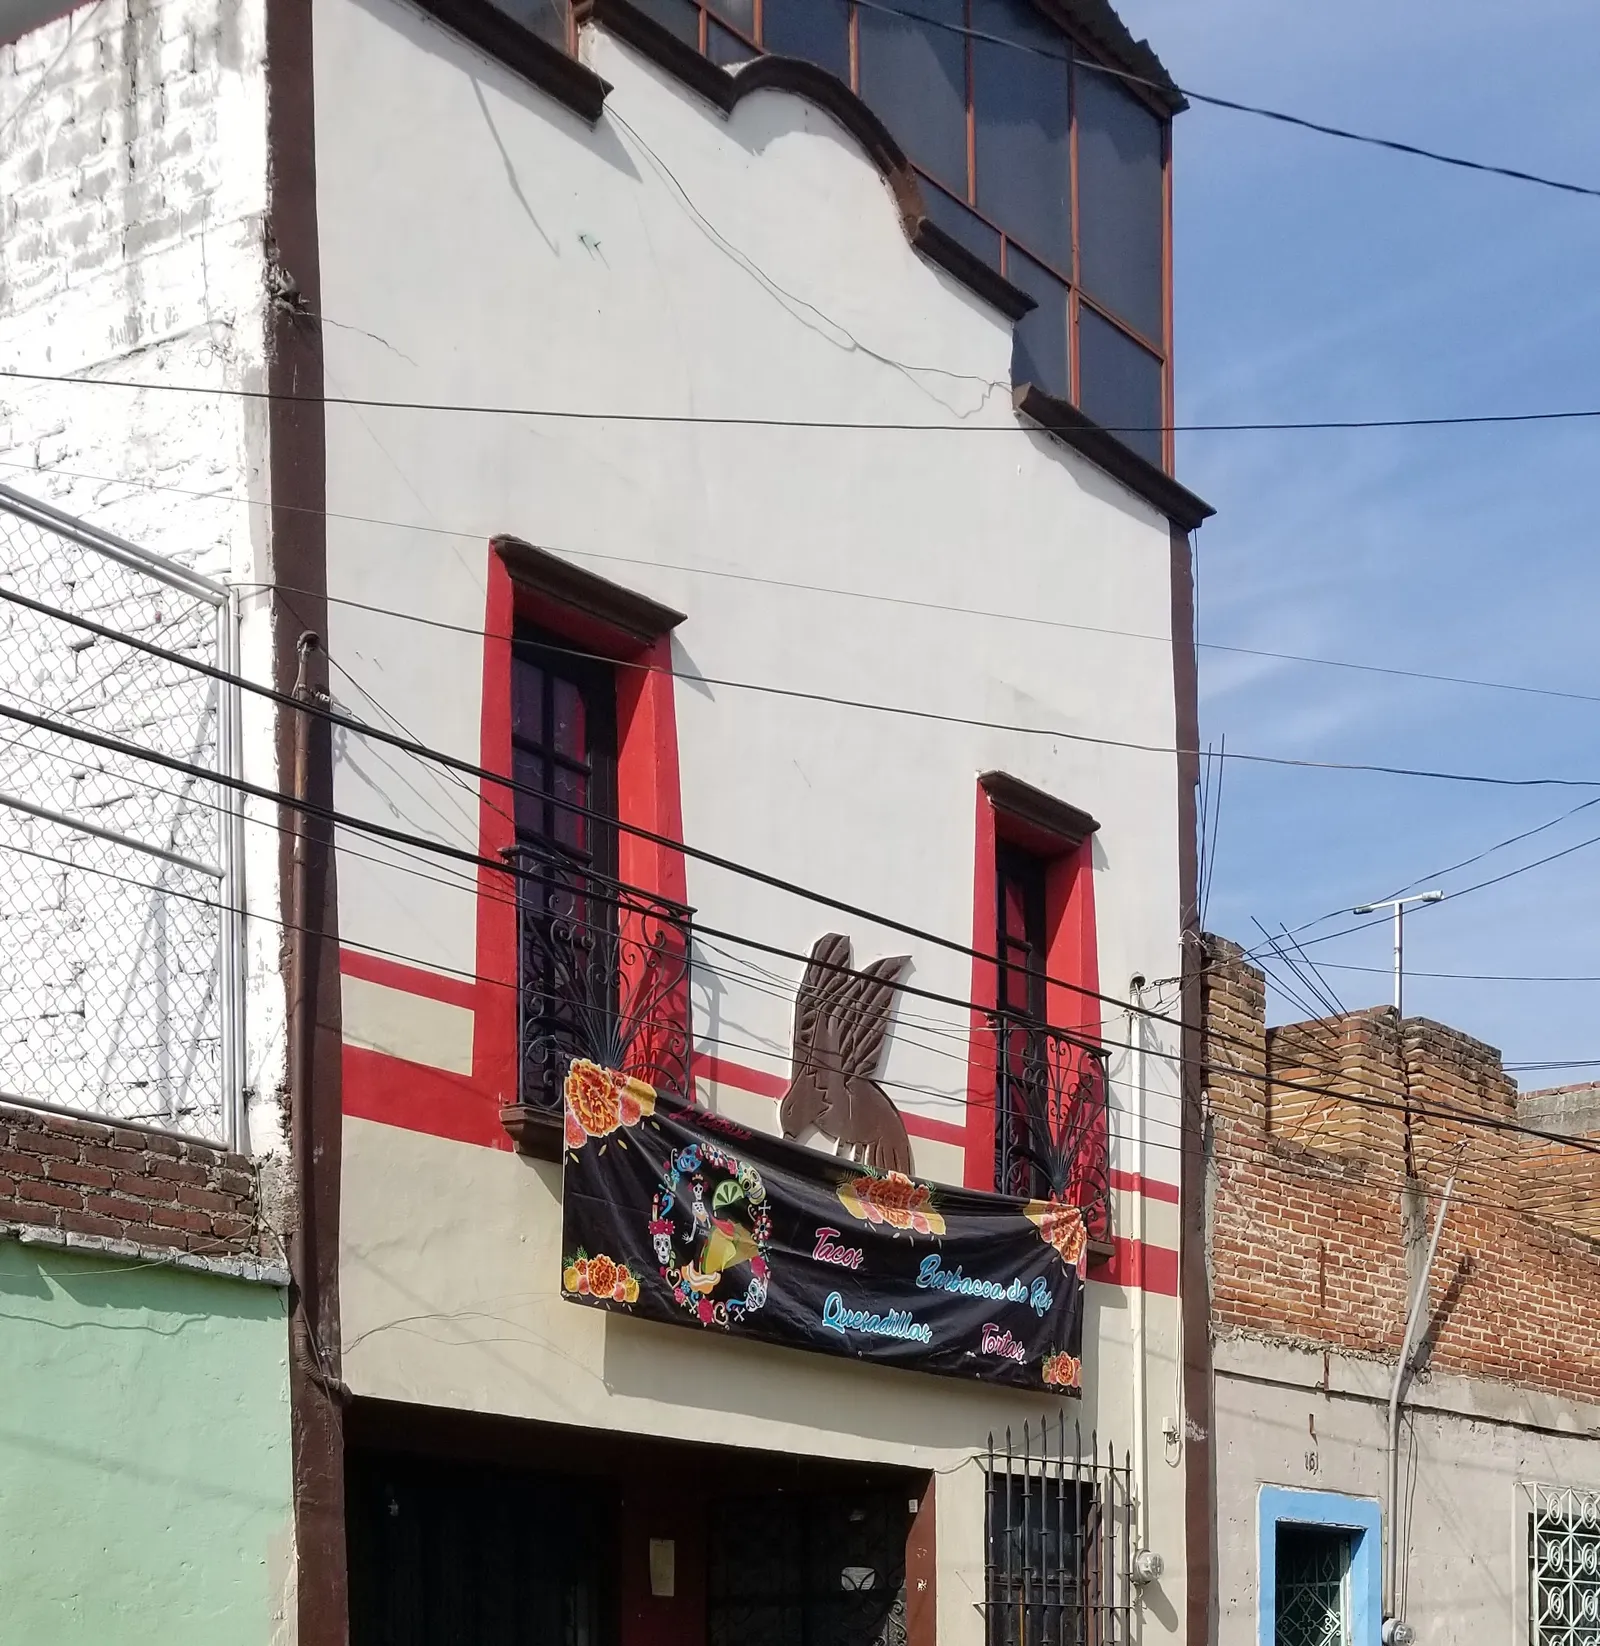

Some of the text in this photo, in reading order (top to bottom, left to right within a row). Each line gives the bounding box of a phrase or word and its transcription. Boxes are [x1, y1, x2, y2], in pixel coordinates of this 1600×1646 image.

[812, 1227, 863, 1269] Tacos
[915, 1254, 1053, 1317] Barbacoa de Res
[822, 1292, 933, 1343] Quesadillas
[981, 1323, 1026, 1360] Tortas
